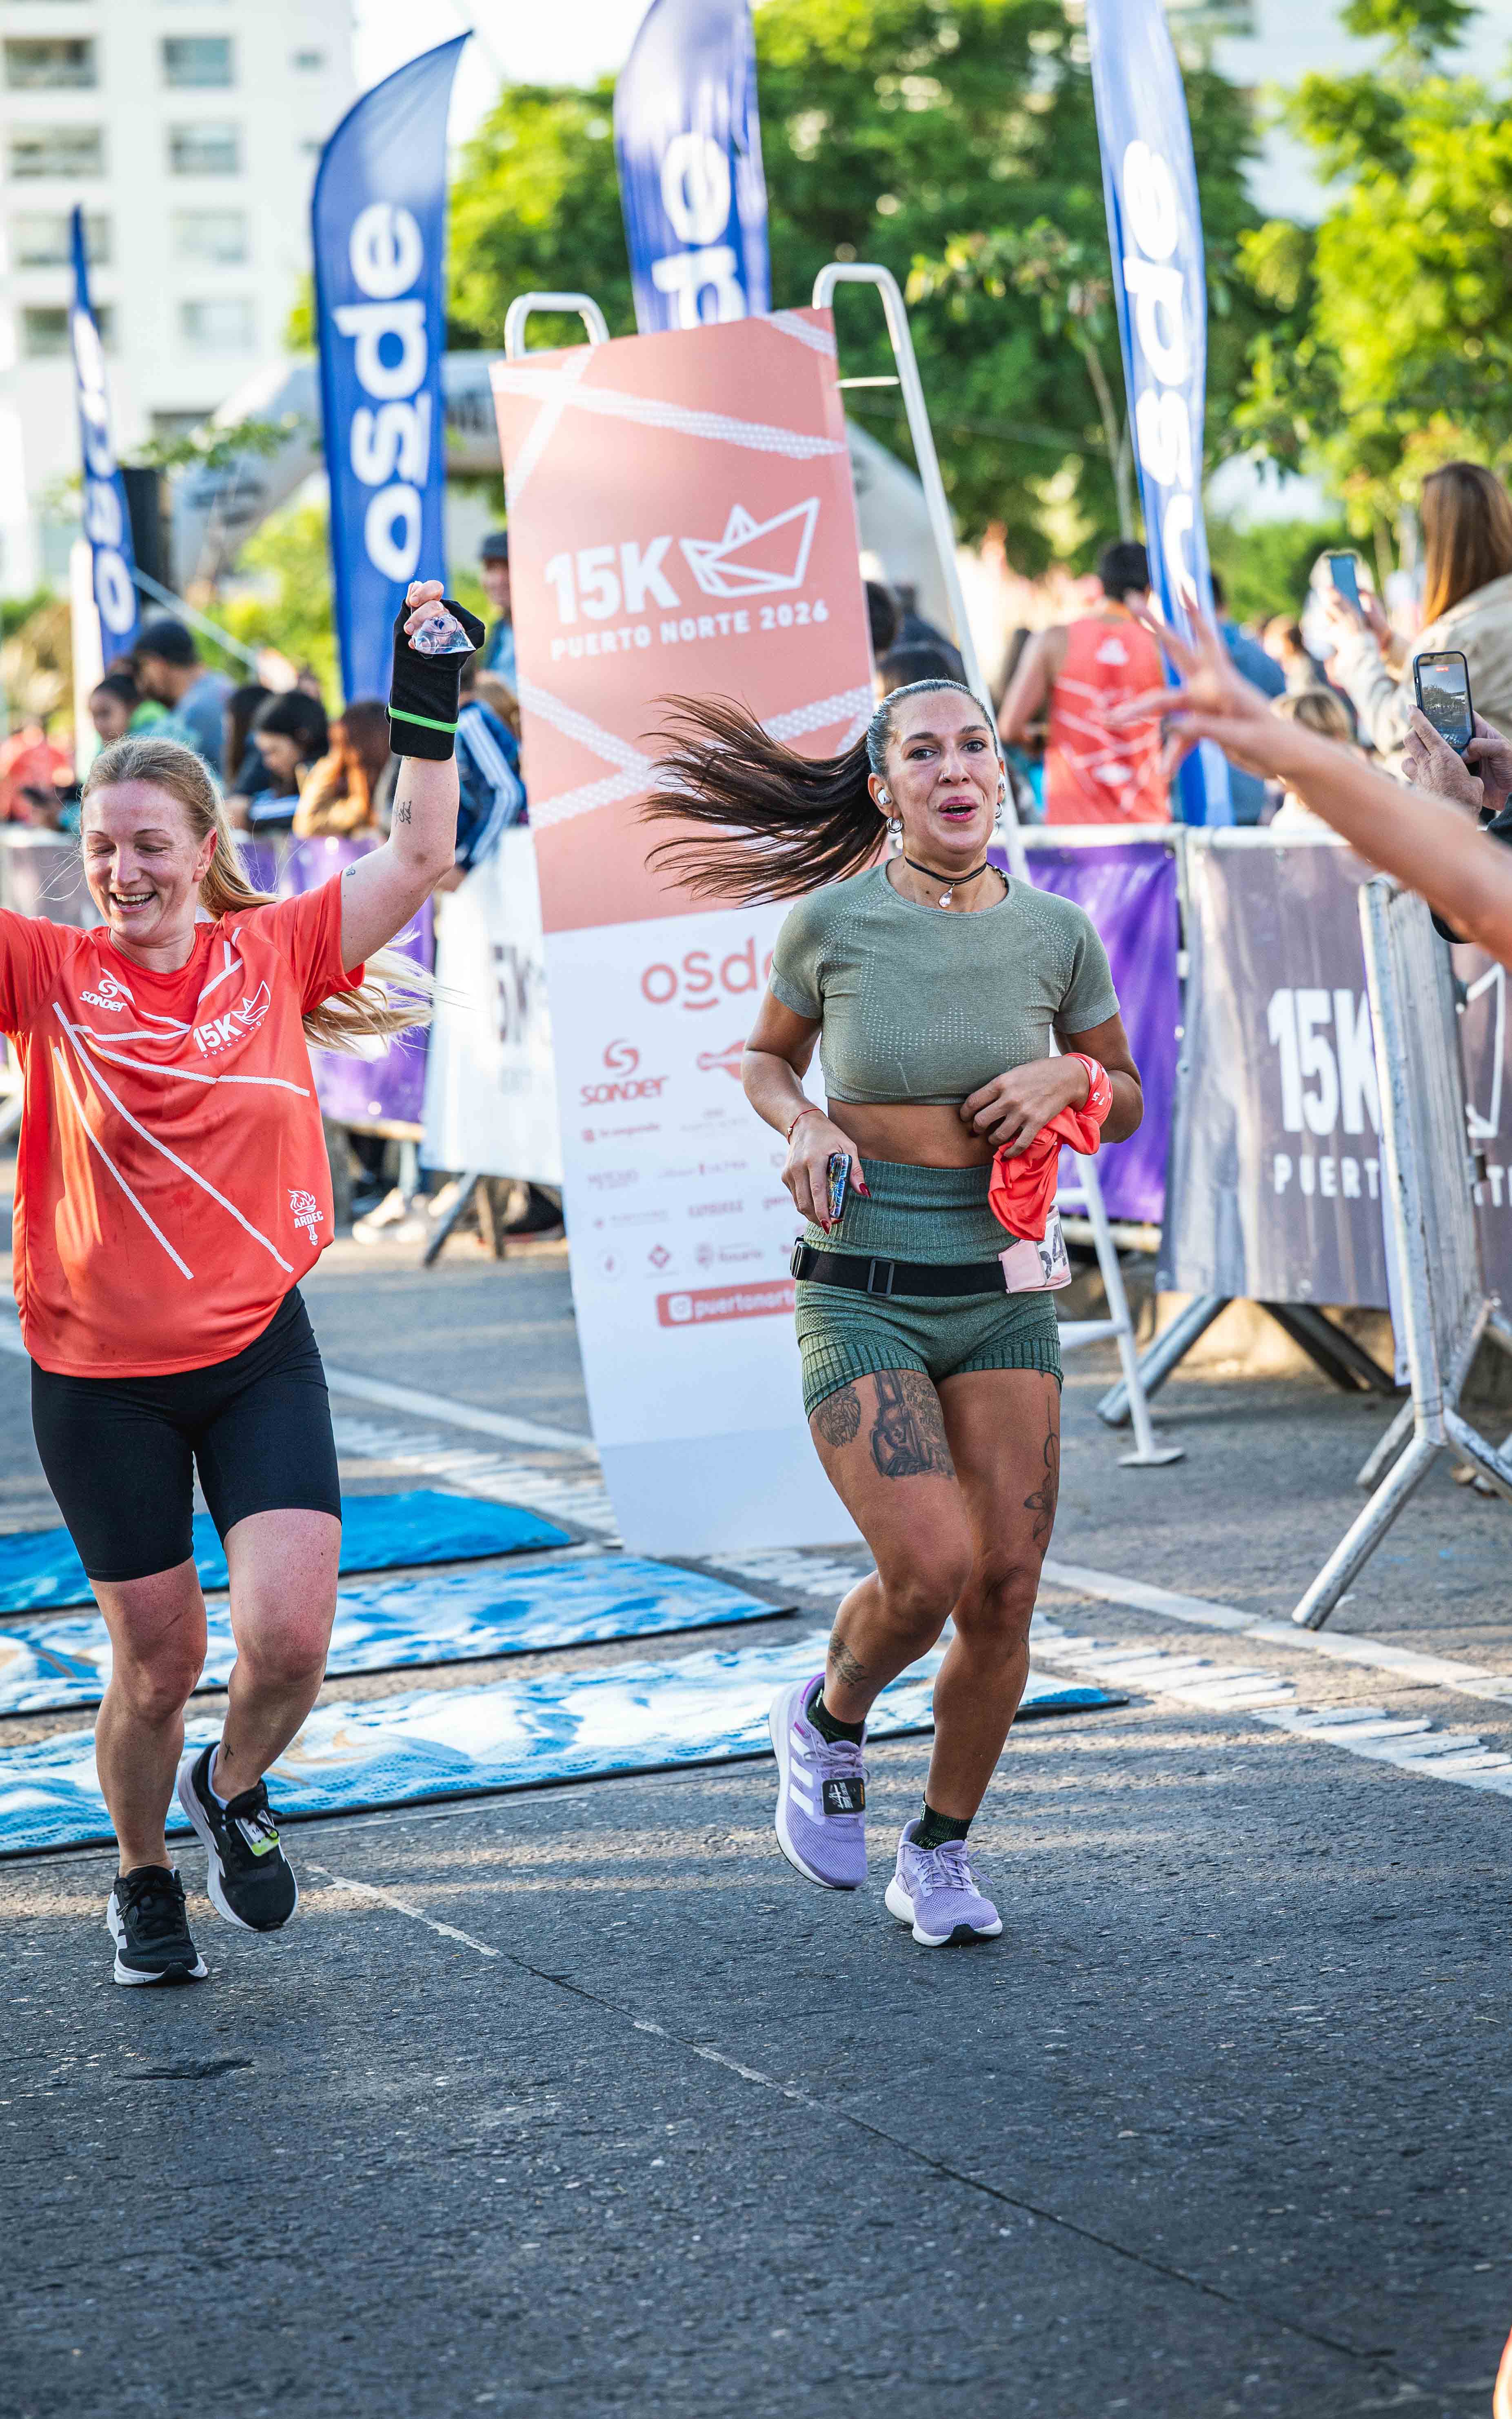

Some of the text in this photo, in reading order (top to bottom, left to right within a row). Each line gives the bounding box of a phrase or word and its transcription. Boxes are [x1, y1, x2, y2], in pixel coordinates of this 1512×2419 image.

[333, 202, 432, 583] osde
[545, 535, 681, 624] 15K
[551, 599, 828, 661] PUERTO NORTE 2026
[193, 1013, 243, 1052] 15K
[203, 1034, 246, 1058] PUERTO
[1267, 988, 1383, 1135] 15K
[1274, 1153, 1379, 1200] PUERT
[294, 1211, 324, 1228] ARDEC
